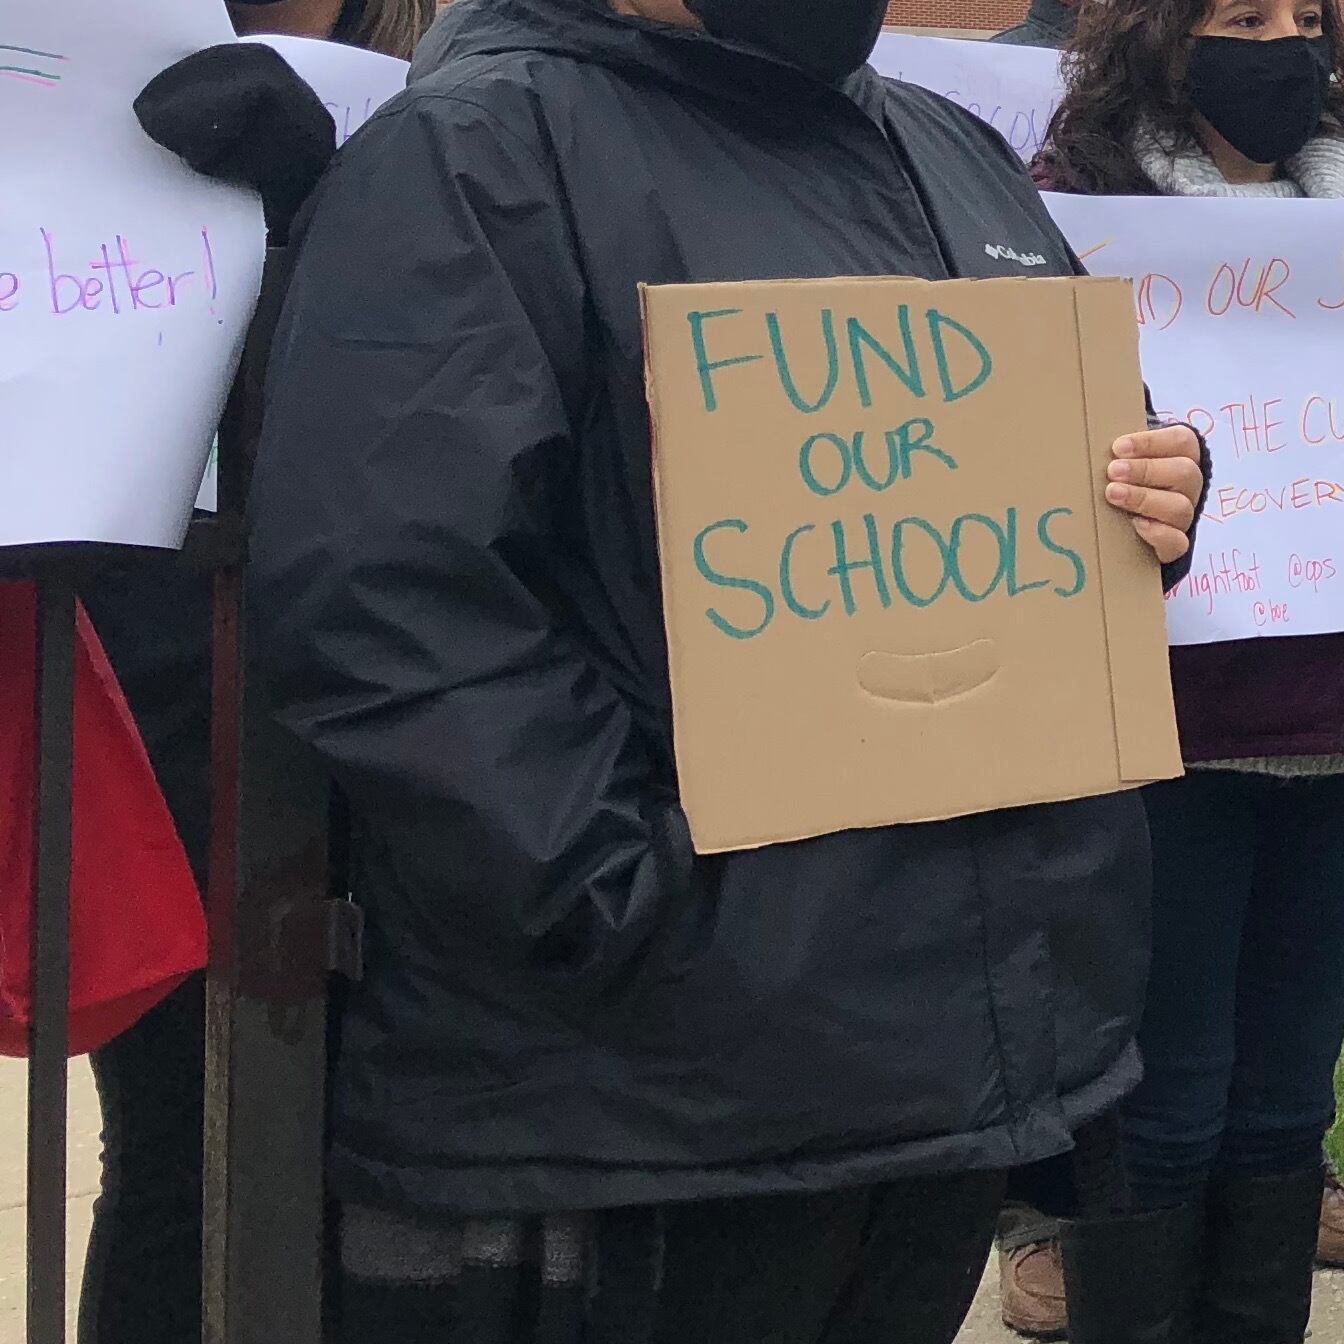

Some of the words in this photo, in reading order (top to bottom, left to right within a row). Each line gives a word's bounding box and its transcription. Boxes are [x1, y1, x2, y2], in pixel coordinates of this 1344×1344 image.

[40, 224, 223, 324] better!
[1207, 257, 1296, 318] OUR
[688, 304, 993, 413] FUND
[799, 417, 958, 495] OUR
[1220, 395, 1287, 458] THE
[693, 507, 1086, 639] SCHOOLS
